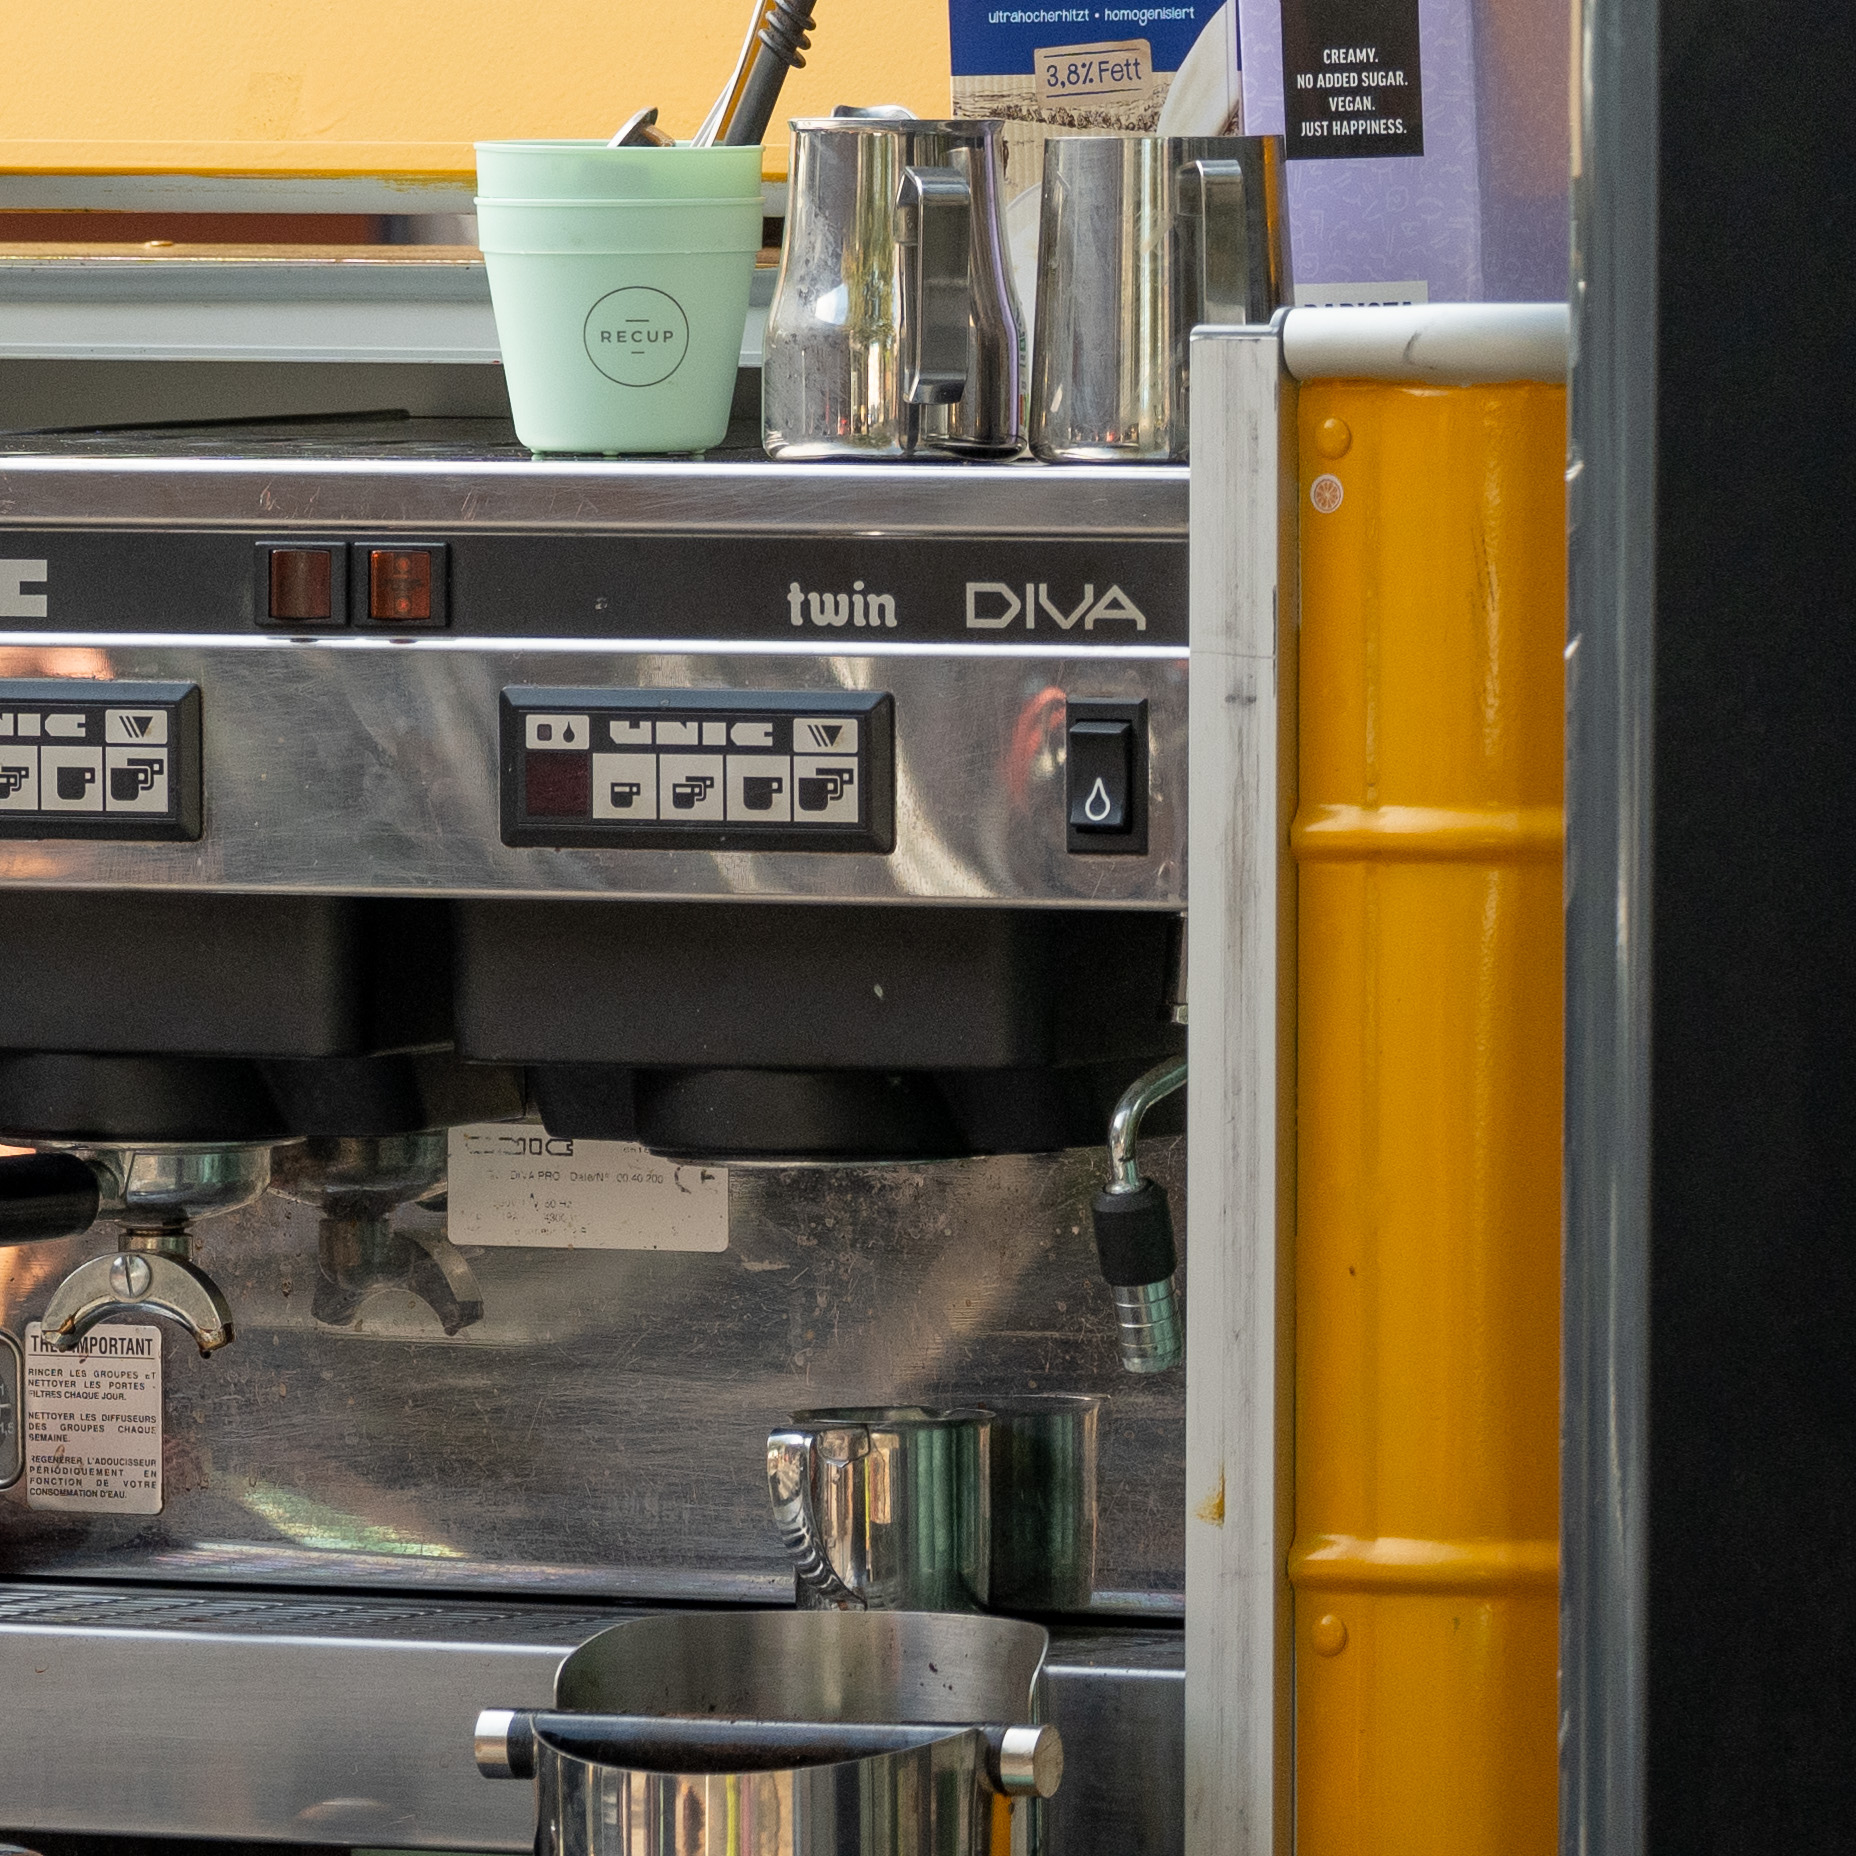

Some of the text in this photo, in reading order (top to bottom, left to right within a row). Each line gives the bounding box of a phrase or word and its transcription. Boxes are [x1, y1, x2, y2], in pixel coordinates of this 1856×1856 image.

[989, 6, 1195, 26] ultrahocherhitzt homogenisiert
[1323, 47, 1378, 64] CREAMY.
[1046, 58, 1142, 88] 3,8% Fett
[1297, 71, 1408, 89] NO ADDED SUGAR.
[1329, 95, 1376, 112] VEGAN.
[1301, 119, 1407, 137] JUST HAPPINESS.
[600, 330, 674, 343] RECUP
[788, 580, 1147, 631] twin DIVA
[609, 720, 773, 747] UNIC
[73, 1337, 153, 1356] MPORTANT
[28, 1368, 63, 1377] RINCER
[70, 1369, 87, 1377] LES
[93, 1370, 139, 1379] GROUPES
[28, 1379, 76, 1388] NETTOYER
[84, 1380, 101, 1388] LES
[108, 1381, 145, 1390] PORTES
[64, 1391, 99, 1399] CHAQUE
[101, 1392, 126, 1400] JOUR.
[28, 1412, 156, 1423] NETTOYER LES DIFFUSEURS
[28, 1423, 156, 1434] DES GROUPES CHAQUE
[143, 1470, 157, 1478] EN
[29, 1477, 156, 1489] FONCTION DE VOTRE
[29, 1488, 97, 1498] CONSOMMATION
